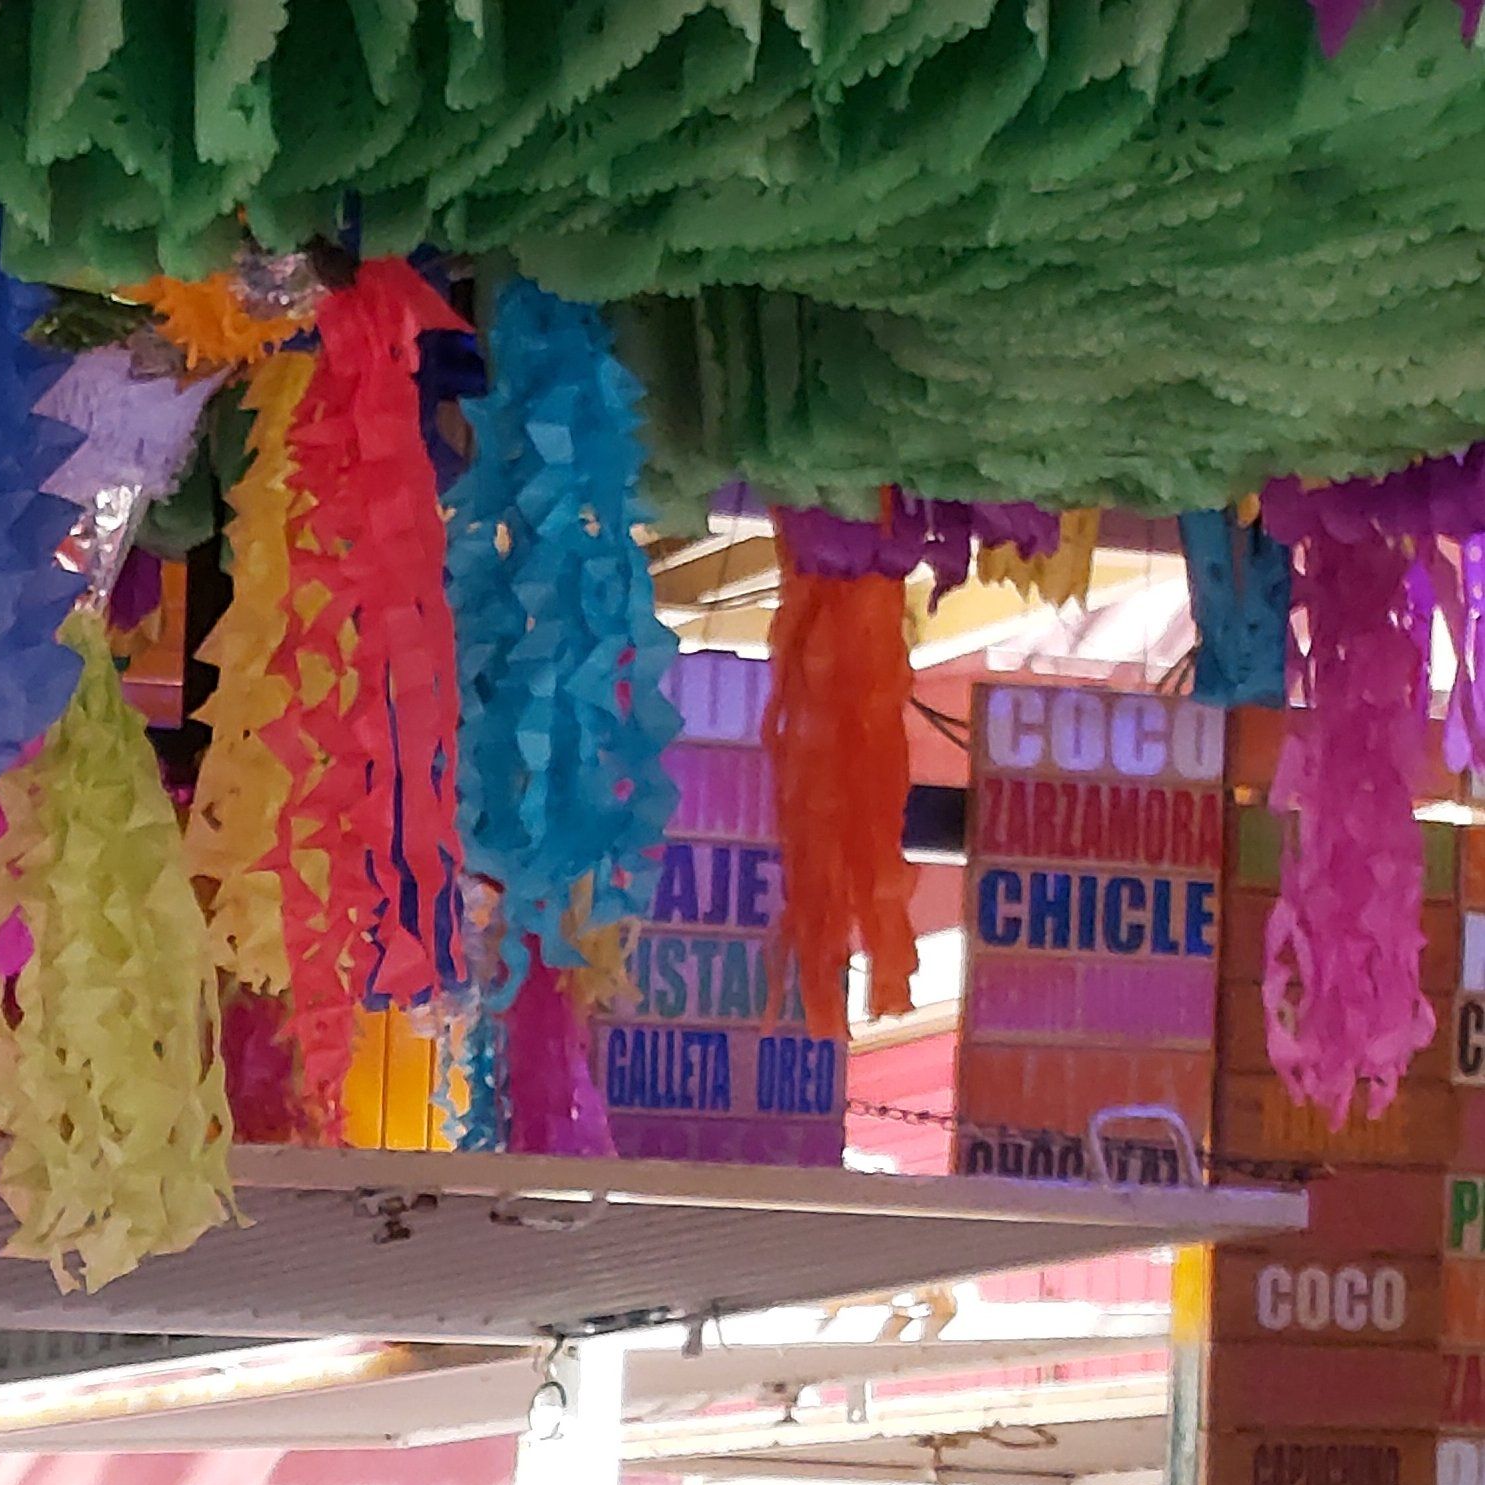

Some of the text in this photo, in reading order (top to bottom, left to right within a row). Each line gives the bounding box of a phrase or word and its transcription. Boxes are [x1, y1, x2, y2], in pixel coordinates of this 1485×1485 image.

[987, 686, 1225, 779] COCO
[979, 779, 1221, 870] ZARZAMORA
[978, 869, 1215, 957] CHICLE
[608, 1029, 836, 1114] GALLETA OREO
[1255, 1266, 1406, 1332] COCO
